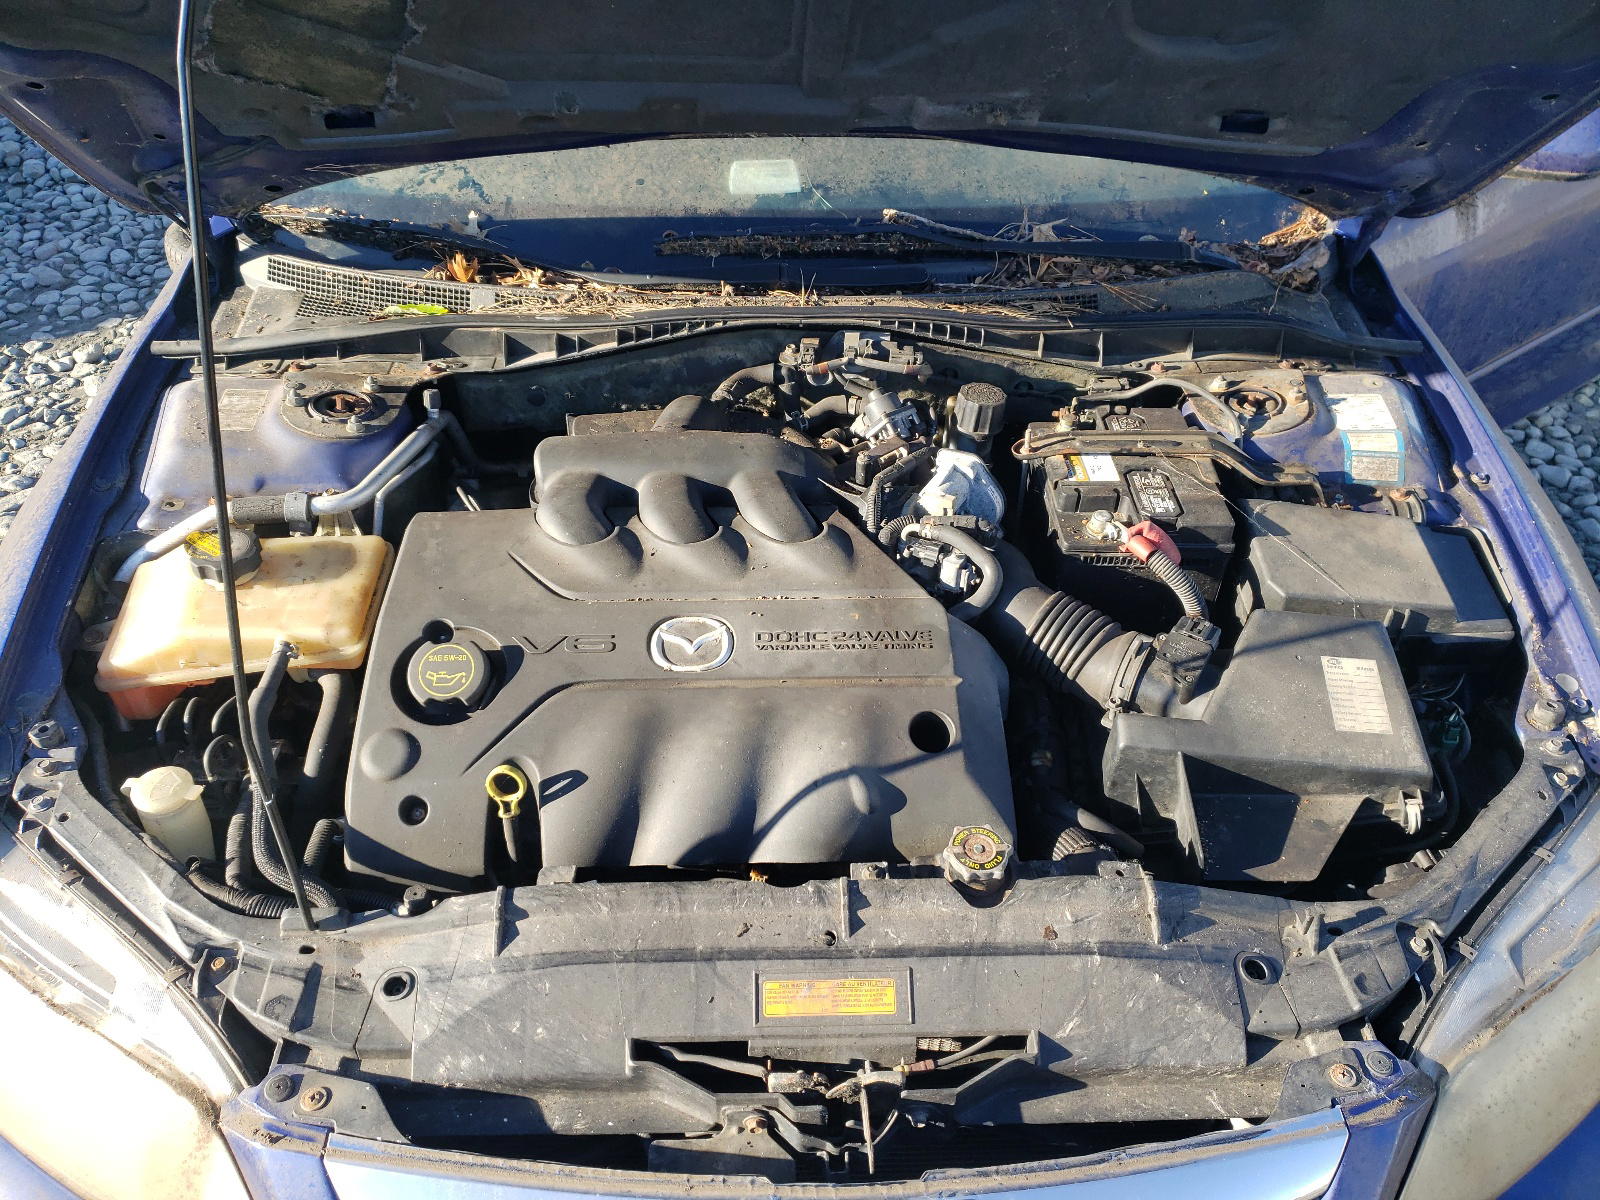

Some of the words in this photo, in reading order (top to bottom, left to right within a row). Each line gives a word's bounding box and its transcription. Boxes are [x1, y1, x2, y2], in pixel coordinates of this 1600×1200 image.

[754, 630, 828, 643] DOHC
[830, 630, 932, 642] 24-VALVE
[512, 633, 617, 654] V6
[754, 643, 831, 651] VARIABLE
[831, 643, 879, 651] VALVE
[443, 654, 467, 662] 5W-20
[953, 830, 970, 847] POWER
[971, 828, 1001, 844] STEERING
[959, 857, 980, 870] ONLY
[984, 855, 1003, 869] FLUID
